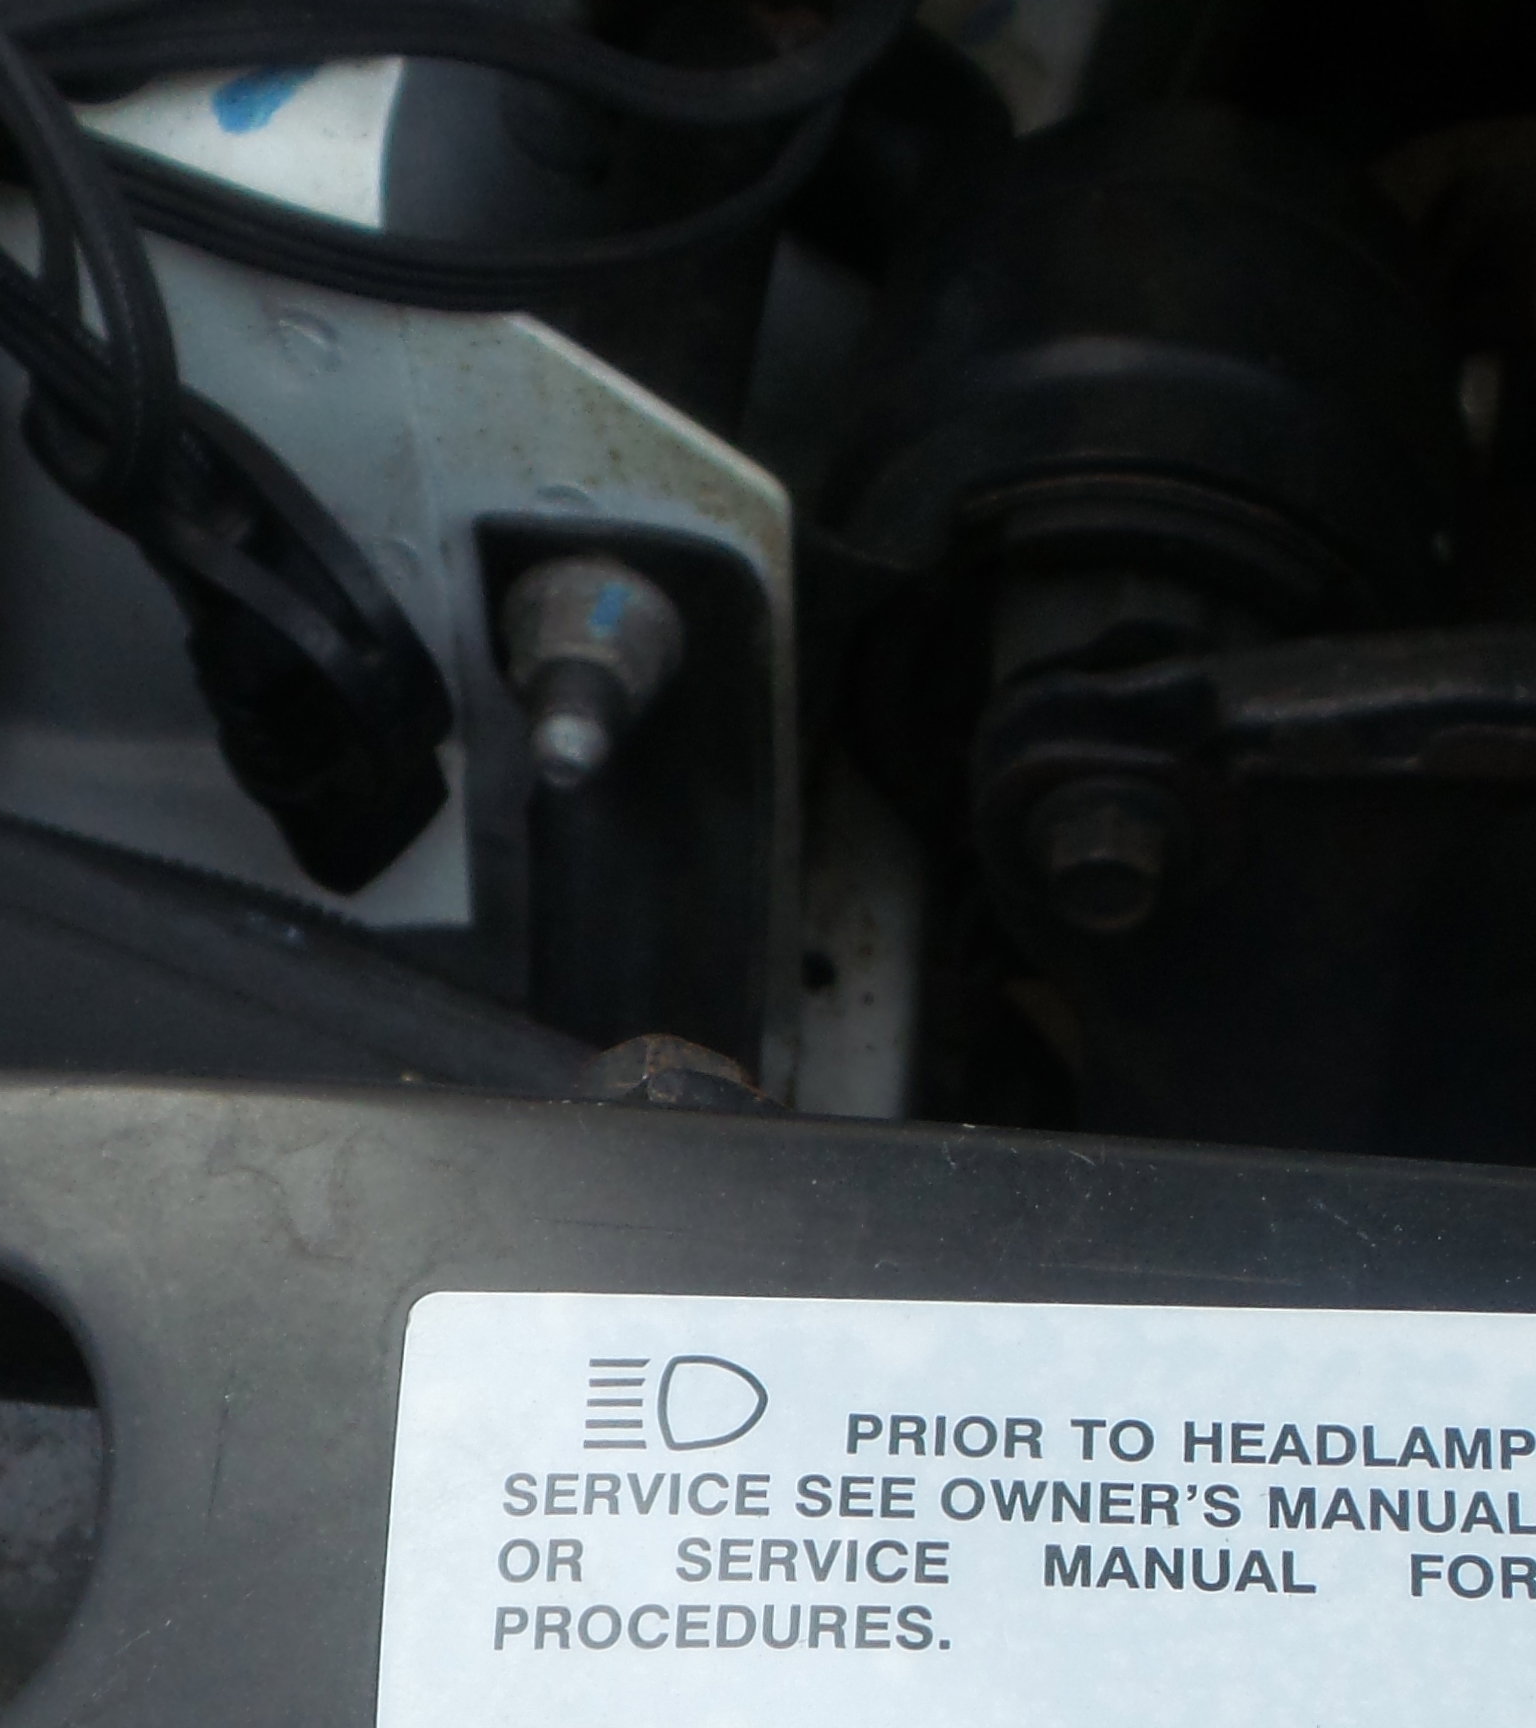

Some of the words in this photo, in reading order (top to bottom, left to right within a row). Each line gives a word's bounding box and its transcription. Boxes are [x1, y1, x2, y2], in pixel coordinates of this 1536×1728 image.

[846, 1413, 1043, 1459] PRIOR
[1070, 1418, 1155, 1463] TO
[1183, 1421, 1536, 1470] HEADLAMP
[502, 1472, 771, 1518] SERVICE
[795, 1474, 916, 1519] SEE
[940, 1475, 1241, 1528] OWNER'S
[497, 1538, 584, 1583] OR
[676, 1537, 950, 1585] SERVICE
[1044, 1544, 1317, 1594] MANUAL
[494, 1604, 952, 1651] PROCEDURES.
